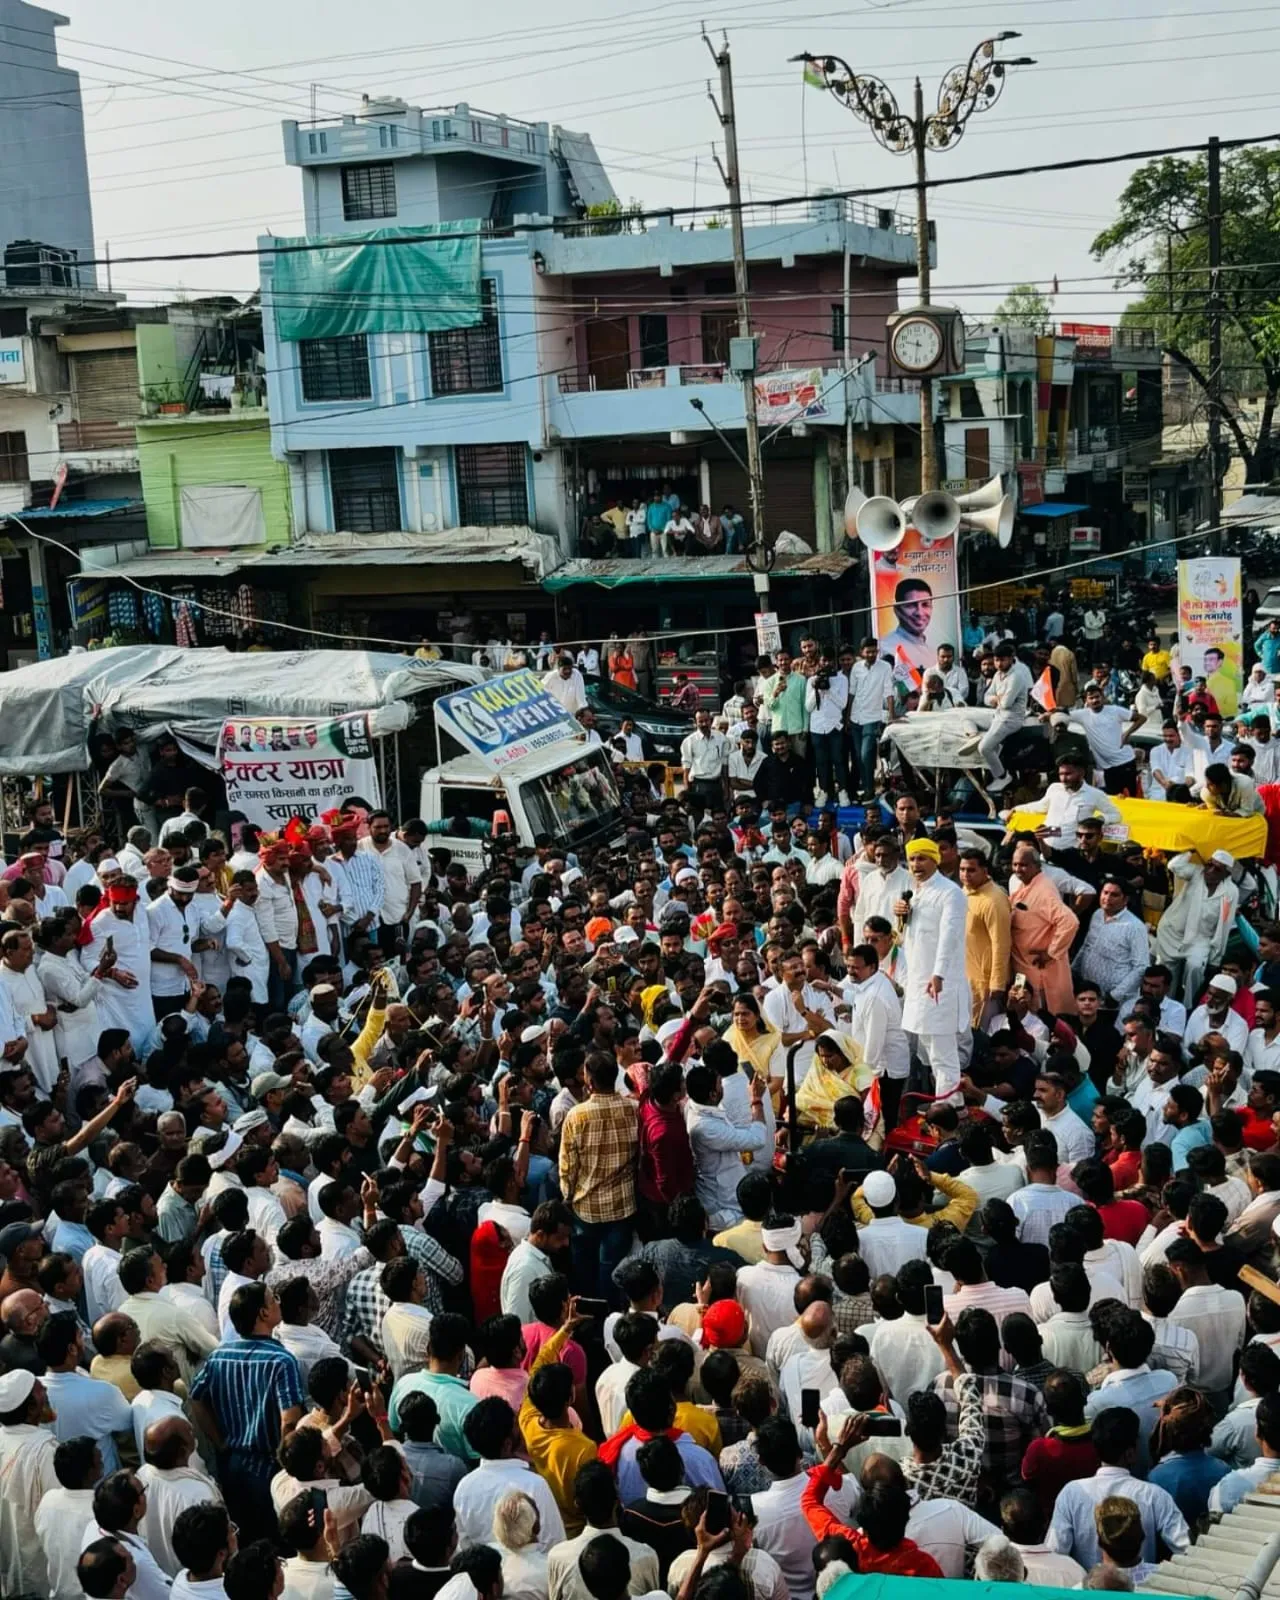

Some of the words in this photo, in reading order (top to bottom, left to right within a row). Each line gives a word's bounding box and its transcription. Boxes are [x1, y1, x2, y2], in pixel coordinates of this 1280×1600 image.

[471, 672, 546, 713] KALOTA
[496, 697, 568, 735] EVENTS
[339, 718, 366, 740] 19
[287, 758, 344, 781] यात्रा
[243, 789, 271, 800] समस्त
[307, 787, 321, 797] का
[264, 802, 319, 821] स्वागत
